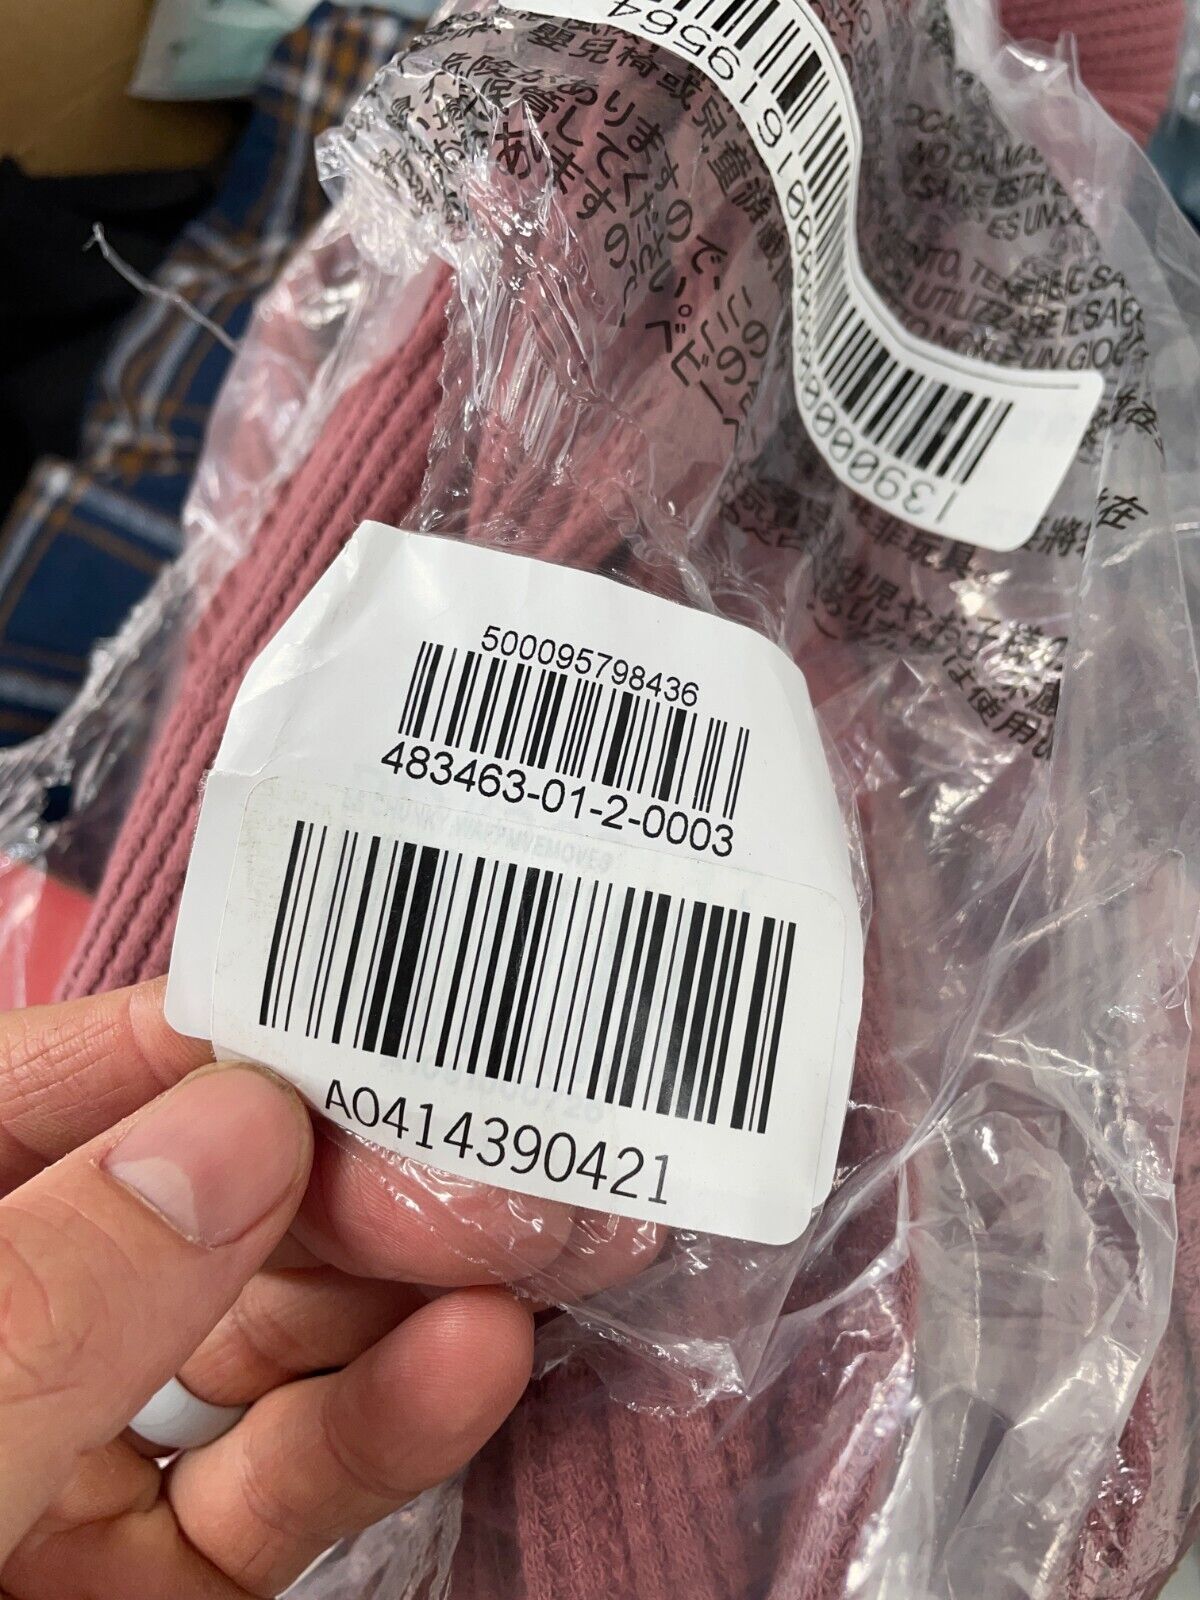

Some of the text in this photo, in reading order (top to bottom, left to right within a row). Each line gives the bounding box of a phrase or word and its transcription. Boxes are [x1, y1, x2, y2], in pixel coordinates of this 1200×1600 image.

[481, 625, 700, 707] 500095798436
[380, 741, 735, 857] 483463-01-2-0003
[324, 1078, 670, 1206] A0414390421
